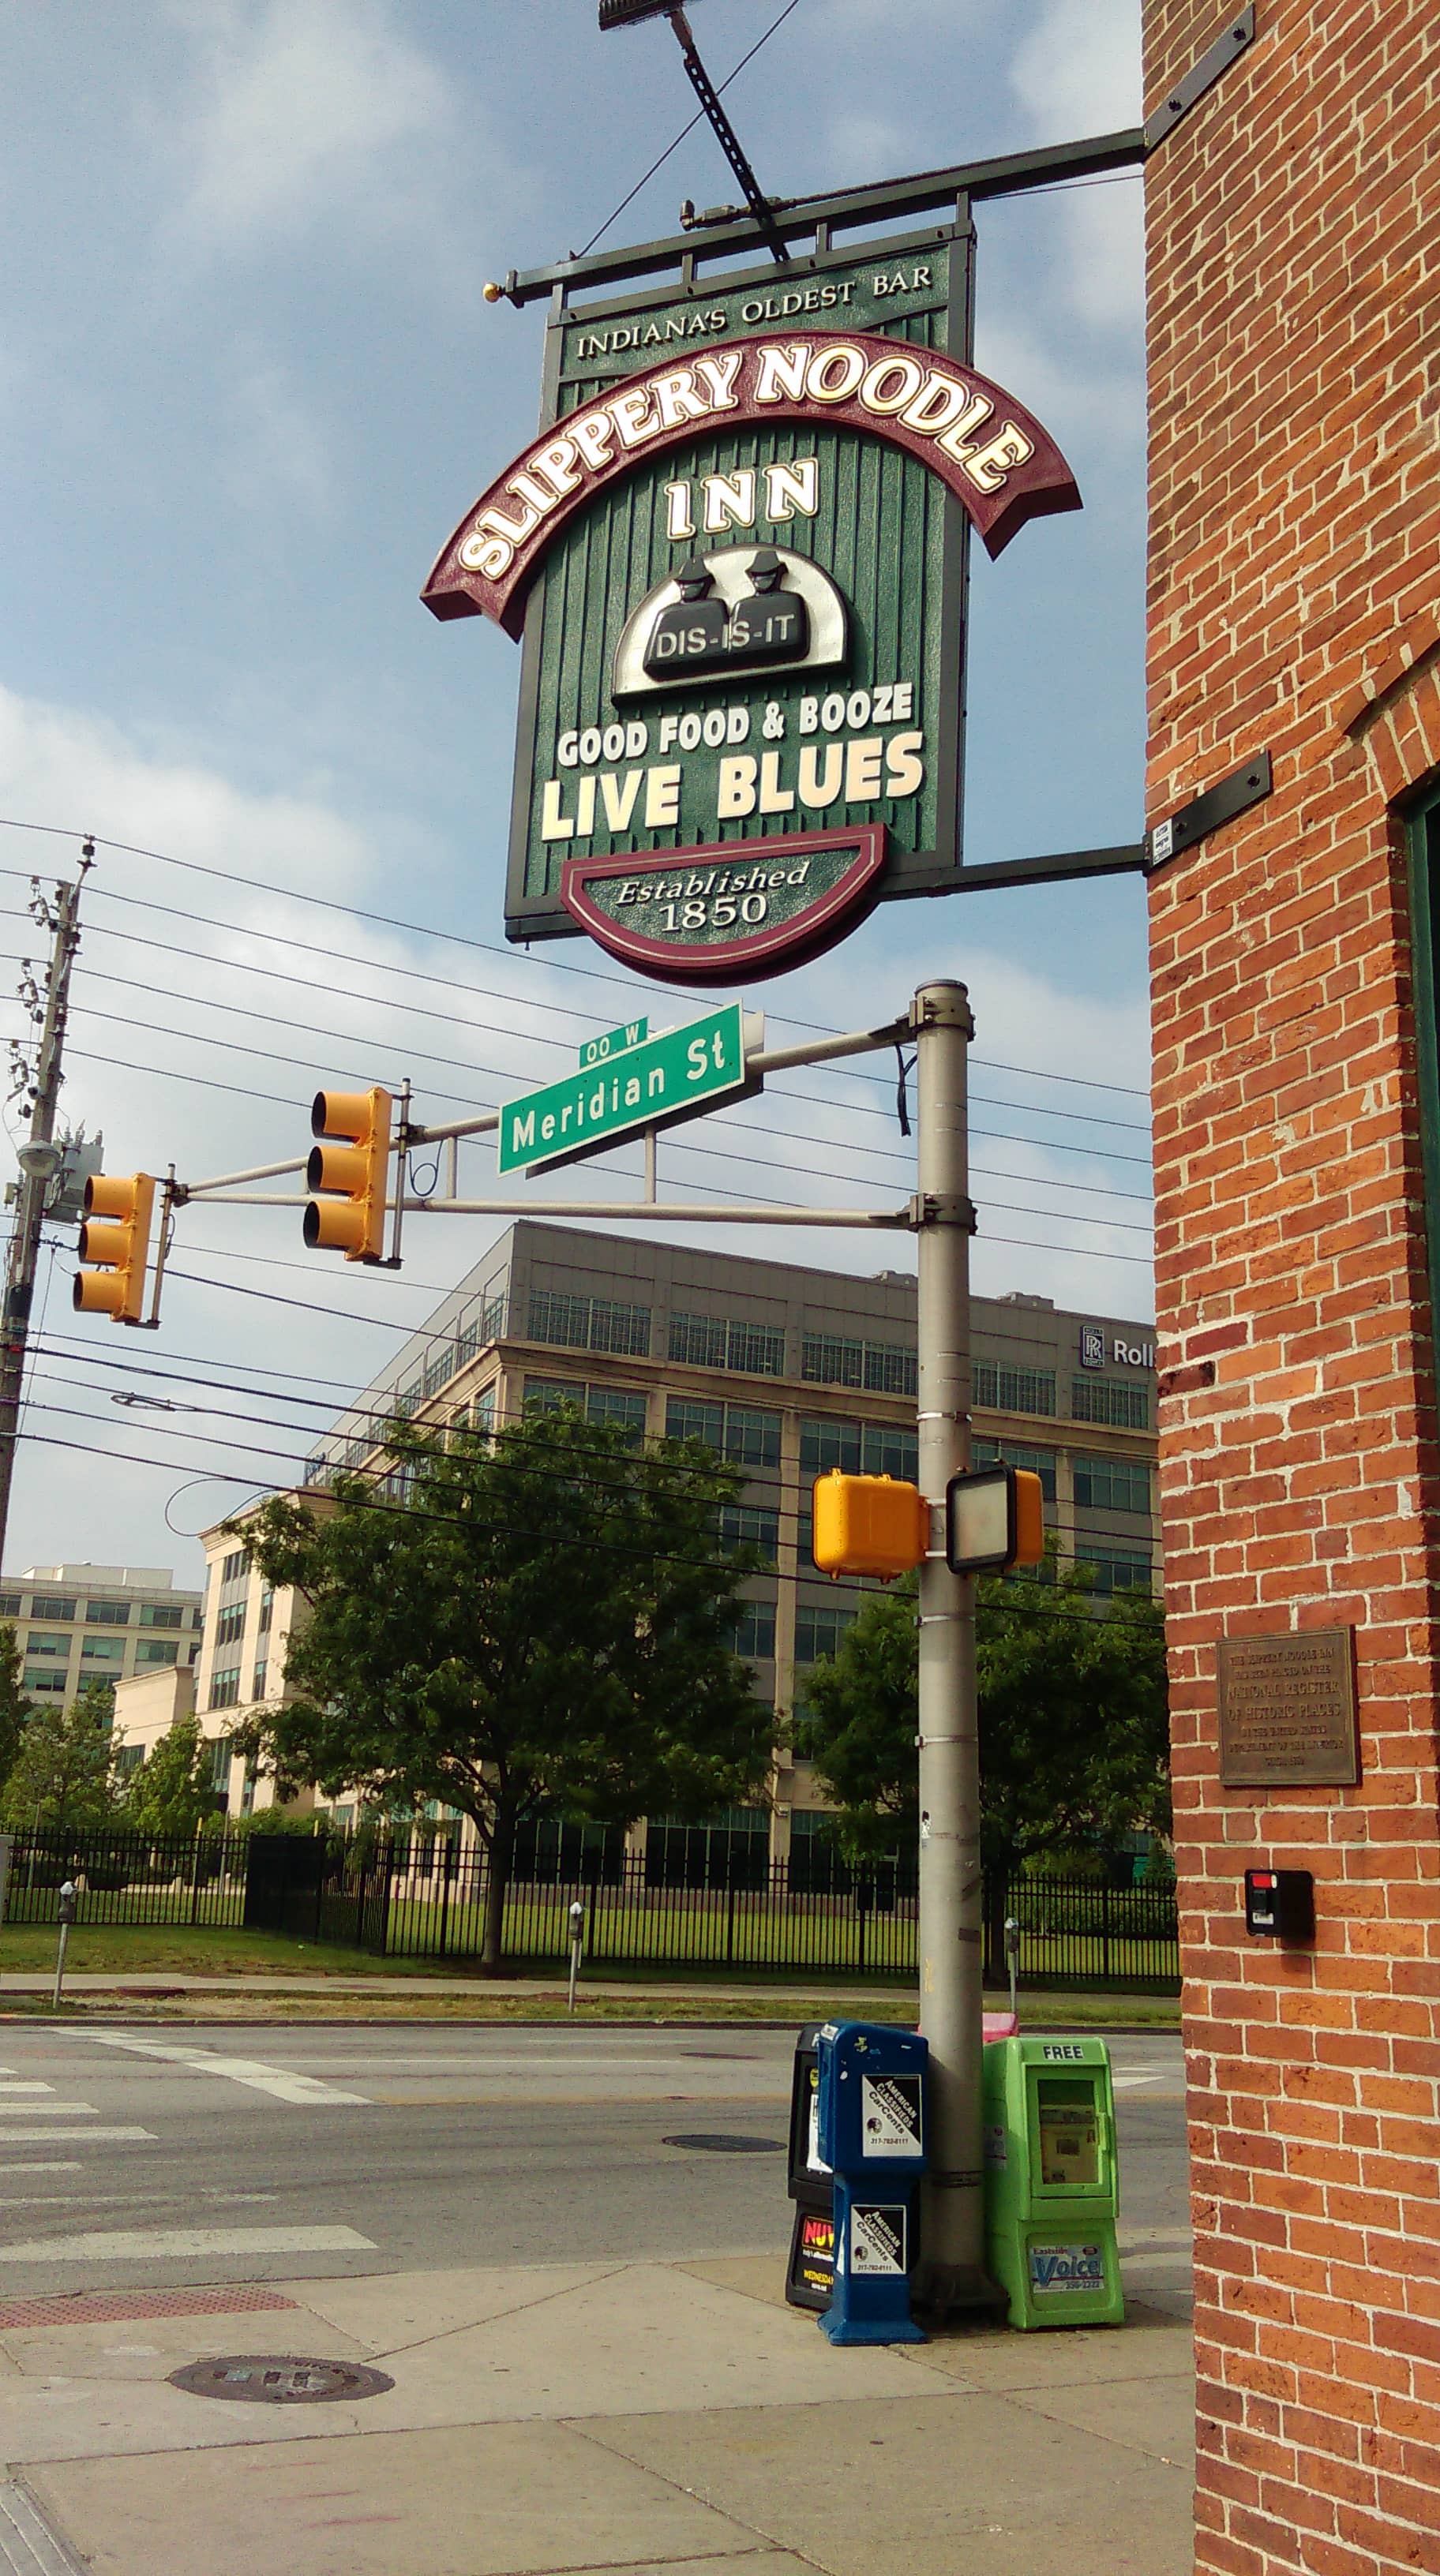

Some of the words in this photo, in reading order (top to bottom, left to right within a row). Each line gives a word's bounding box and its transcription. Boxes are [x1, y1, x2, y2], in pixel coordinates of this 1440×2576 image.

[576, 309, 727, 358] INDIANA'S
[741, 282, 857, 324] OLDEST
[873, 265, 932, 298] BAR
[459, 350, 744, 582] SLIPPERY
[755, 343, 1036, 496] NOODLE
[665, 458, 819, 541] INN
[657, 613, 795, 659] DIS-IS-IT
[557, 721, 648, 767] GOOD
[660, 707, 749, 754] FOOD
[762, 702, 785, 739] &
[799, 683, 913, 734] BOOZE
[542, 763, 681, 841] LIVE
[717, 731, 924, 819] BLUES
[617, 862, 810, 907] Established
[659, 894, 767, 933] 1850
[624, 1024, 639, 1046] W
[512, 1067, 665, 1153] Meridian
[686, 1029, 726, 1081] St
[1284, 1680, 1340, 1696] REGISTER
[1245, 1704, 1296, 1720] HISTORIC
[1299, 1702, 1341, 1718] PLACES
[1043, 2046, 1084, 2059] FREE
[876, 2083, 913, 2128] CLASSIFIEDS
[885, 2080, 917, 2118] AMERICAN
[804, 2221, 834, 2248] NUV
[864, 2213, 898, 2256] CLASSIFIEDS
[871, 2211, 902, 2247] AMERICAN
[1035, 2256, 1101, 2287] Voice
